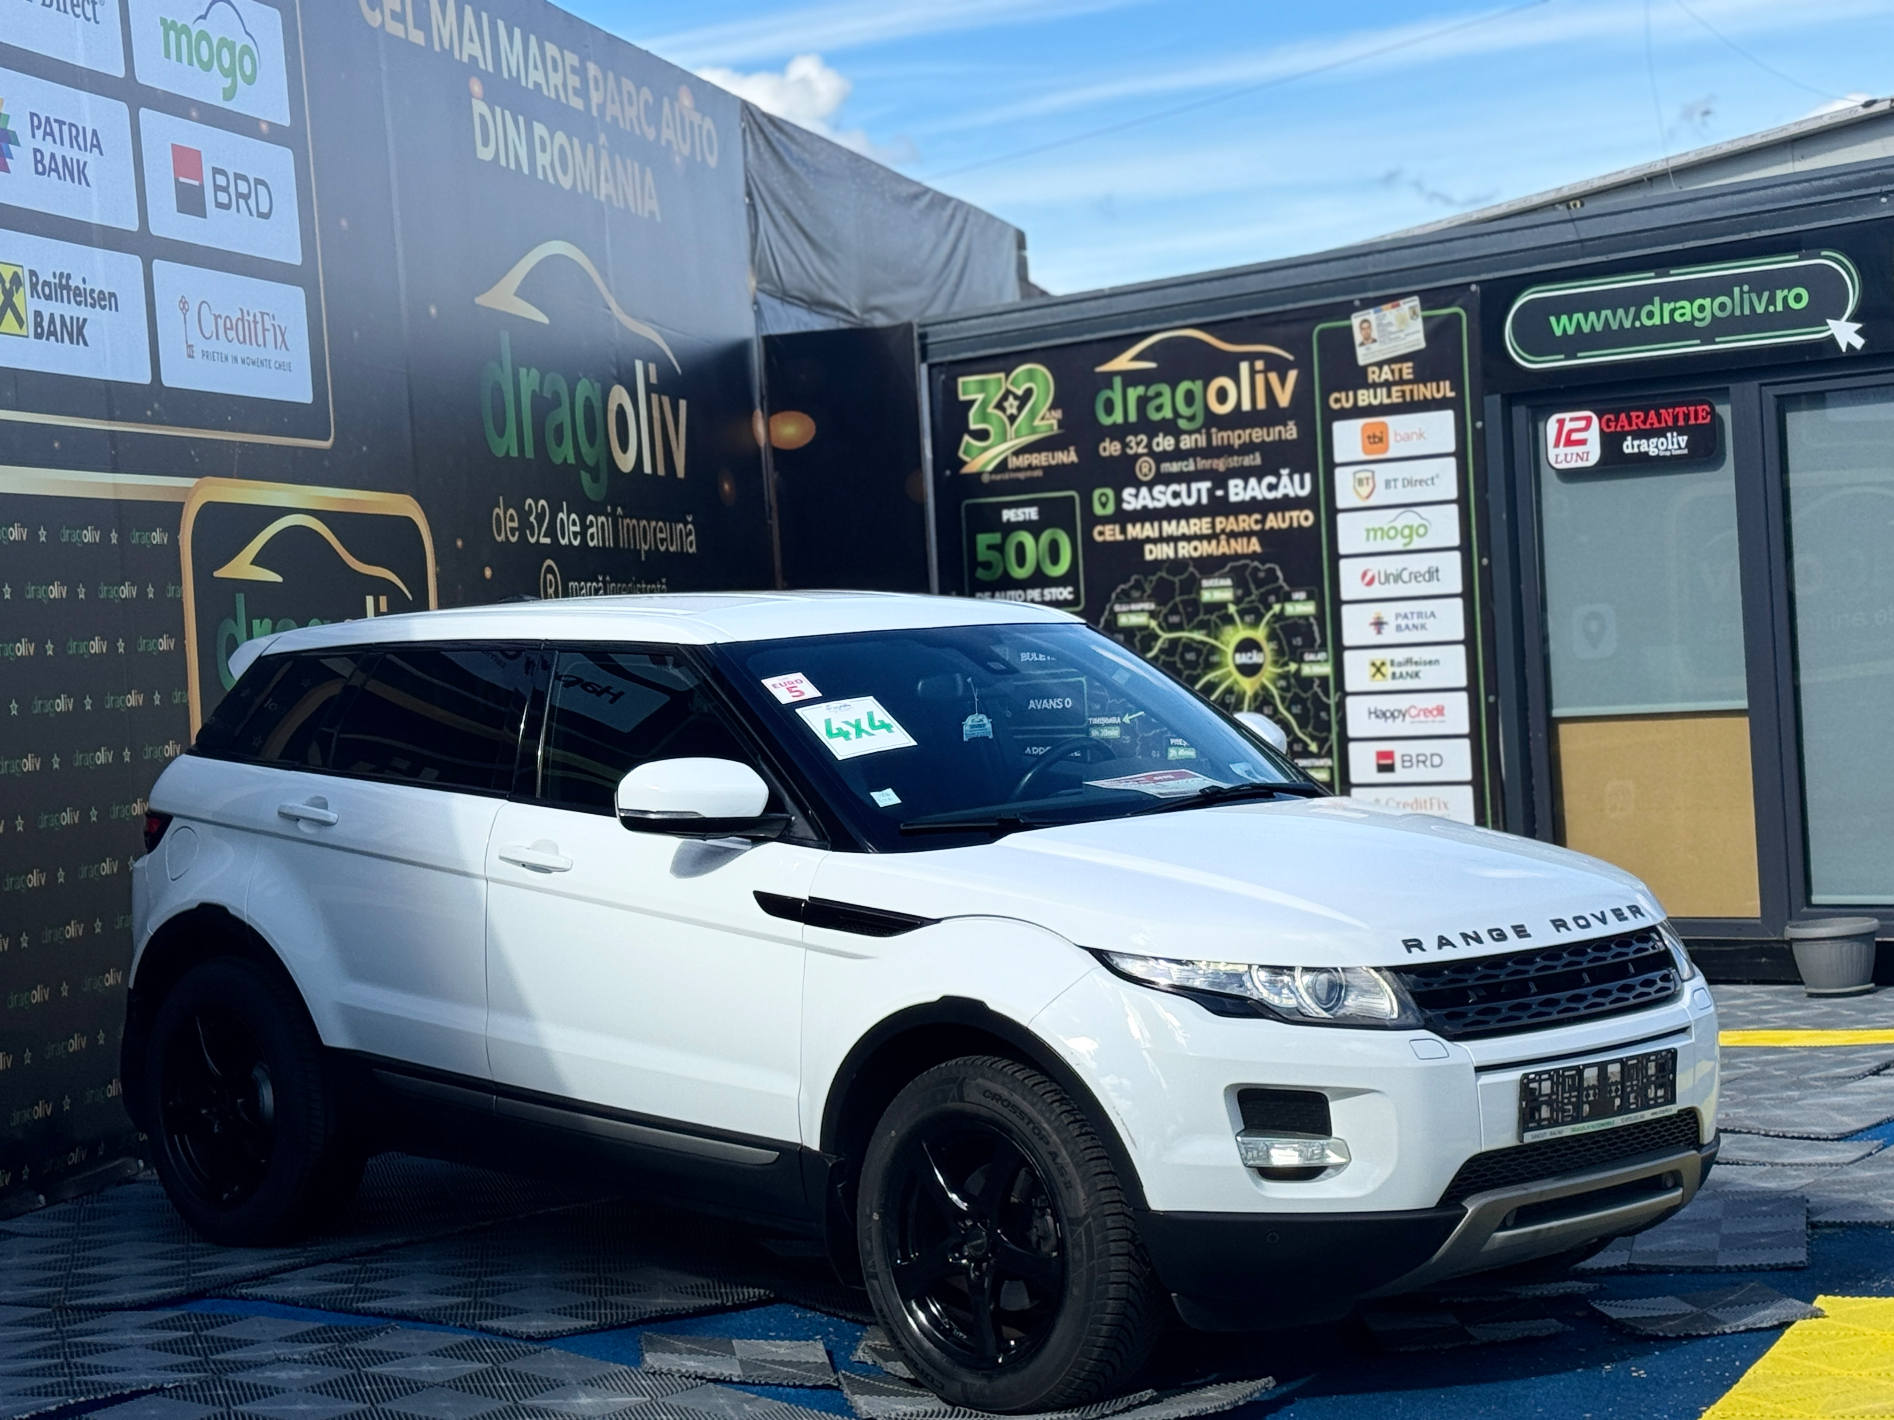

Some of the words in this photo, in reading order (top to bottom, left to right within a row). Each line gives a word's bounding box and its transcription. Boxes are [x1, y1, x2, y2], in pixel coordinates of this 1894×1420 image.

[160, 16, 259, 102] mogo
[430, 0, 494, 73] MAI
[497, 18, 584, 112] MARE
[587, 61, 657, 142] PARC
[661, 96, 718, 169] AUTO
[29, 110, 104, 157] PATRIA
[33, 147, 91, 188] BANK
[471, 97, 529, 175] DIN
[533, 120, 661, 223] ROMÂNIA
[211, 166, 273, 220] BRD
[28, 268, 119, 312] Raiffeisen
[1549, 284, 1809, 337] www.dragoliv.ro
[33, 310, 89, 348] BANK
[197, 300, 290, 352] CreditFix
[201, 349, 229, 365] PRIETEN
[240, 354, 273, 370] MOMENTE
[1367, 363, 1414, 384] RATE
[1094, 360, 1298, 431] dragoliv
[1328, 390, 1354, 410] CU
[1356, 380, 1455, 407] BULETINUL
[482, 330, 687, 502] dragoliv
[958, 363, 1058, 462] 32
[1600, 405, 1711, 432] GARANTIE
[1099, 438, 1122, 457] de
[1125, 435, 1149, 454] 32
[1152, 432, 1175, 452] de
[1178, 431, 1206, 450] ani
[1210, 421, 1298, 450] împreună
[1367, 431, 1384, 446] tbi
[1394, 426, 1427, 444] bank
[1553, 415, 1592, 449] 12
[1622, 431, 1688, 456] dragoliv
[1007, 446, 1078, 469] ÎMPREUNĂ
[1160, 459, 1195, 475] marcă
[1197, 452, 1261, 475] înregistrată
[1554, 451, 1590, 465] LUNI
[1121, 481, 1211, 511] SASCUT
[1228, 469, 1312, 501] BACĂU
[1385, 477, 1399, 490] BT
[492, 497, 518, 543] de
[525, 500, 550, 545] 32
[557, 504, 580, 546] de
[586, 508, 612, 547] ani
[616, 507, 697, 558] împreună
[1002, 508, 1039, 523] PESTE
[1093, 525, 1124, 542] CEL
[1127, 522, 1160, 539] MAI
[1162, 520, 1212, 537] MARE
[1214, 515, 1262, 533] PARC
[1264, 509, 1314, 529] AUTO
[59, 525, 100, 547] dragoliv
[130, 527, 168, 547] dragoliv
[1365, 521, 1428, 547] mogo
[975, 528, 1072, 581] 500
[1144, 543, 1173, 561] DIN
[1178, 535, 1262, 558] ROMÂNIA
[1377, 565, 1440, 587] UniCredit
[24, 581, 67, 603] dragoliv
[98, 581, 137, 602] dragoliv
[994, 590, 1026, 602] AUTO
[1026, 588, 1042, 602] PE
[1043, 586, 1074, 601] STOC
[1395, 610, 1436, 622] PATRIA
[1396, 621, 1428, 632] BANK
[67, 637, 107, 658] dragoliv
[136, 634, 175, 654] dragoliv
[1390, 656, 1440, 669] Raiffeisen
[1391, 668, 1422, 681] BANK
[771, 679, 803, 689] EURO
[785, 686, 805, 697] 5
[32, 694, 74, 715] dragoliv
[104, 690, 144, 710] dragoliv
[1028, 698, 1063, 710] AVANS
[1064, 697, 1072, 708] 0
[1368, 703, 1446, 724] HappyCredit
[72, 747, 113, 767] dragoliv
[142, 741, 181, 759] dragoliv
[1401, 752, 1443, 769] BRD
[37, 808, 79, 829] dragoliv
[3, 871, 46, 893] dragoliv
[77, 857, 118, 880] dragoliv
[41, 920, 84, 944] dragoliv
[1402, 924, 1532, 953] RANGE
[1550, 904, 1646, 933] ROVER
[7, 986, 49, 1009] dragoliv
[81, 969, 122, 992] dragoliv
[44, 1033, 87, 1059] dragoliv
[983, 1090, 1051, 1146] CROSSTOP
